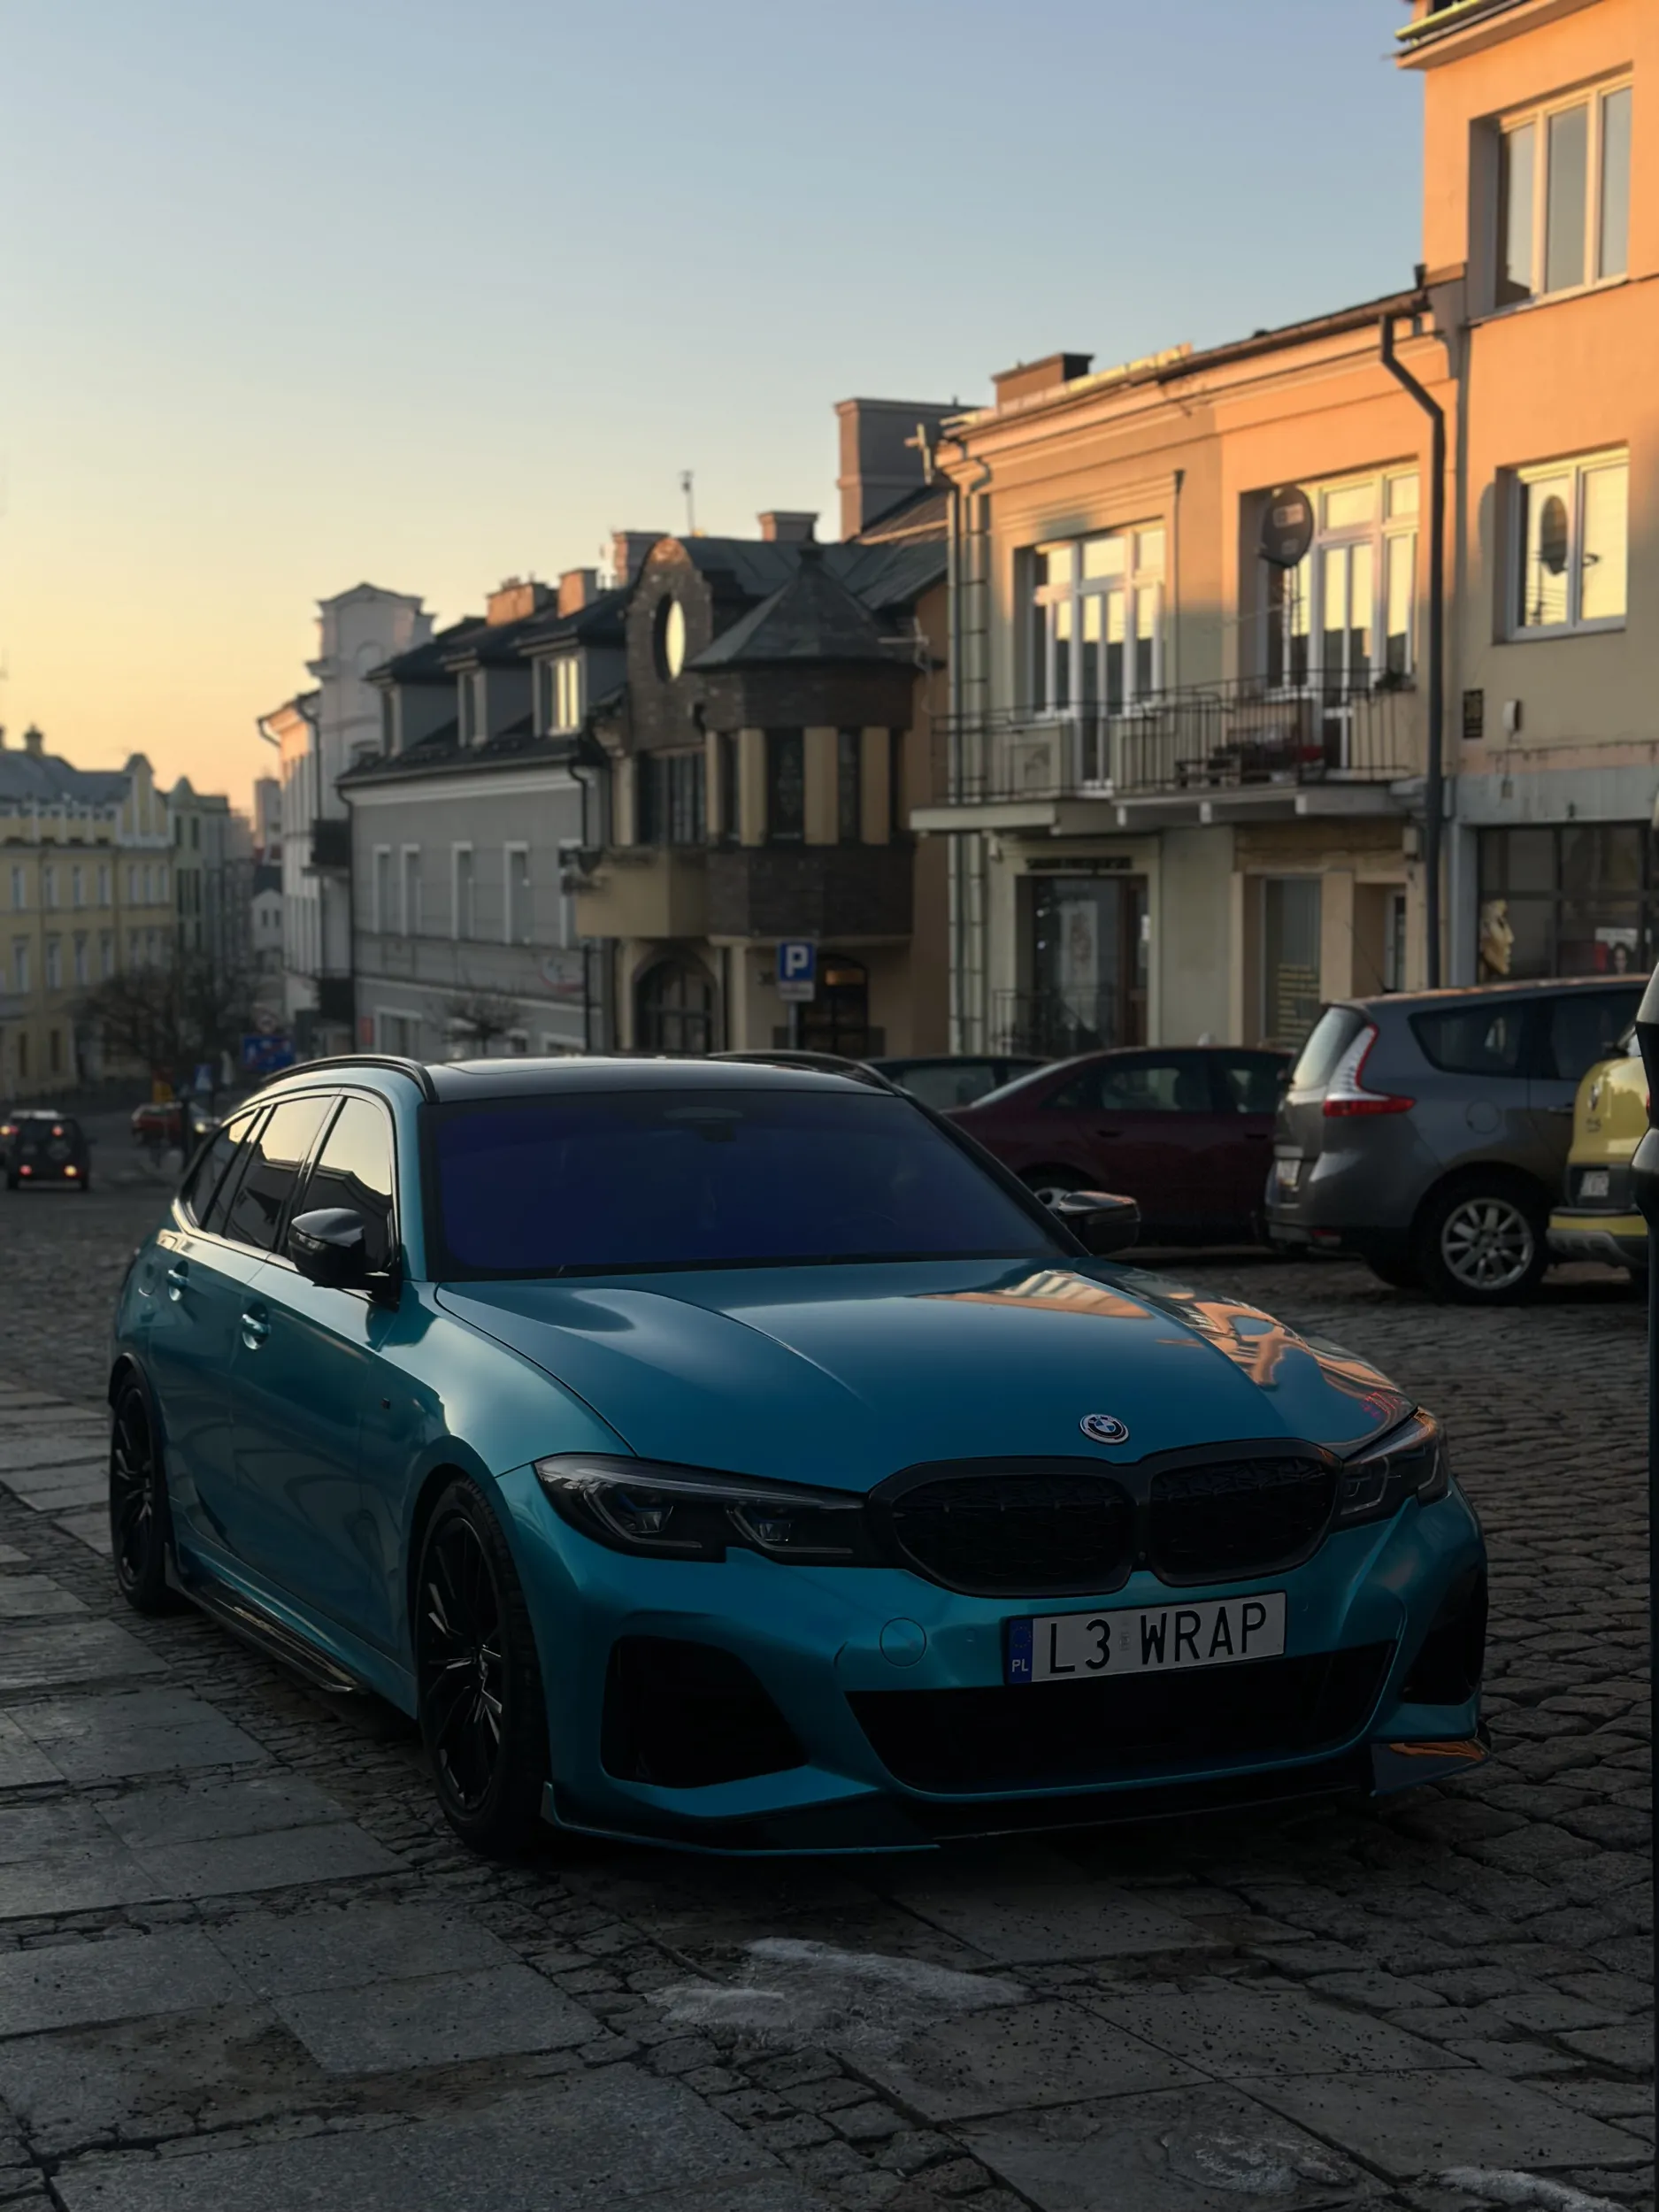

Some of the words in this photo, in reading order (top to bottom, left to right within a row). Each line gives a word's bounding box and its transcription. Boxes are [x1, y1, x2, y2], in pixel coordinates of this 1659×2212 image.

[786, 944, 809, 978] P
[1049, 1618, 1111, 1674] L3
[1140, 1601, 1267, 1665] WRAP
[1011, 1658, 1029, 1673] PL
